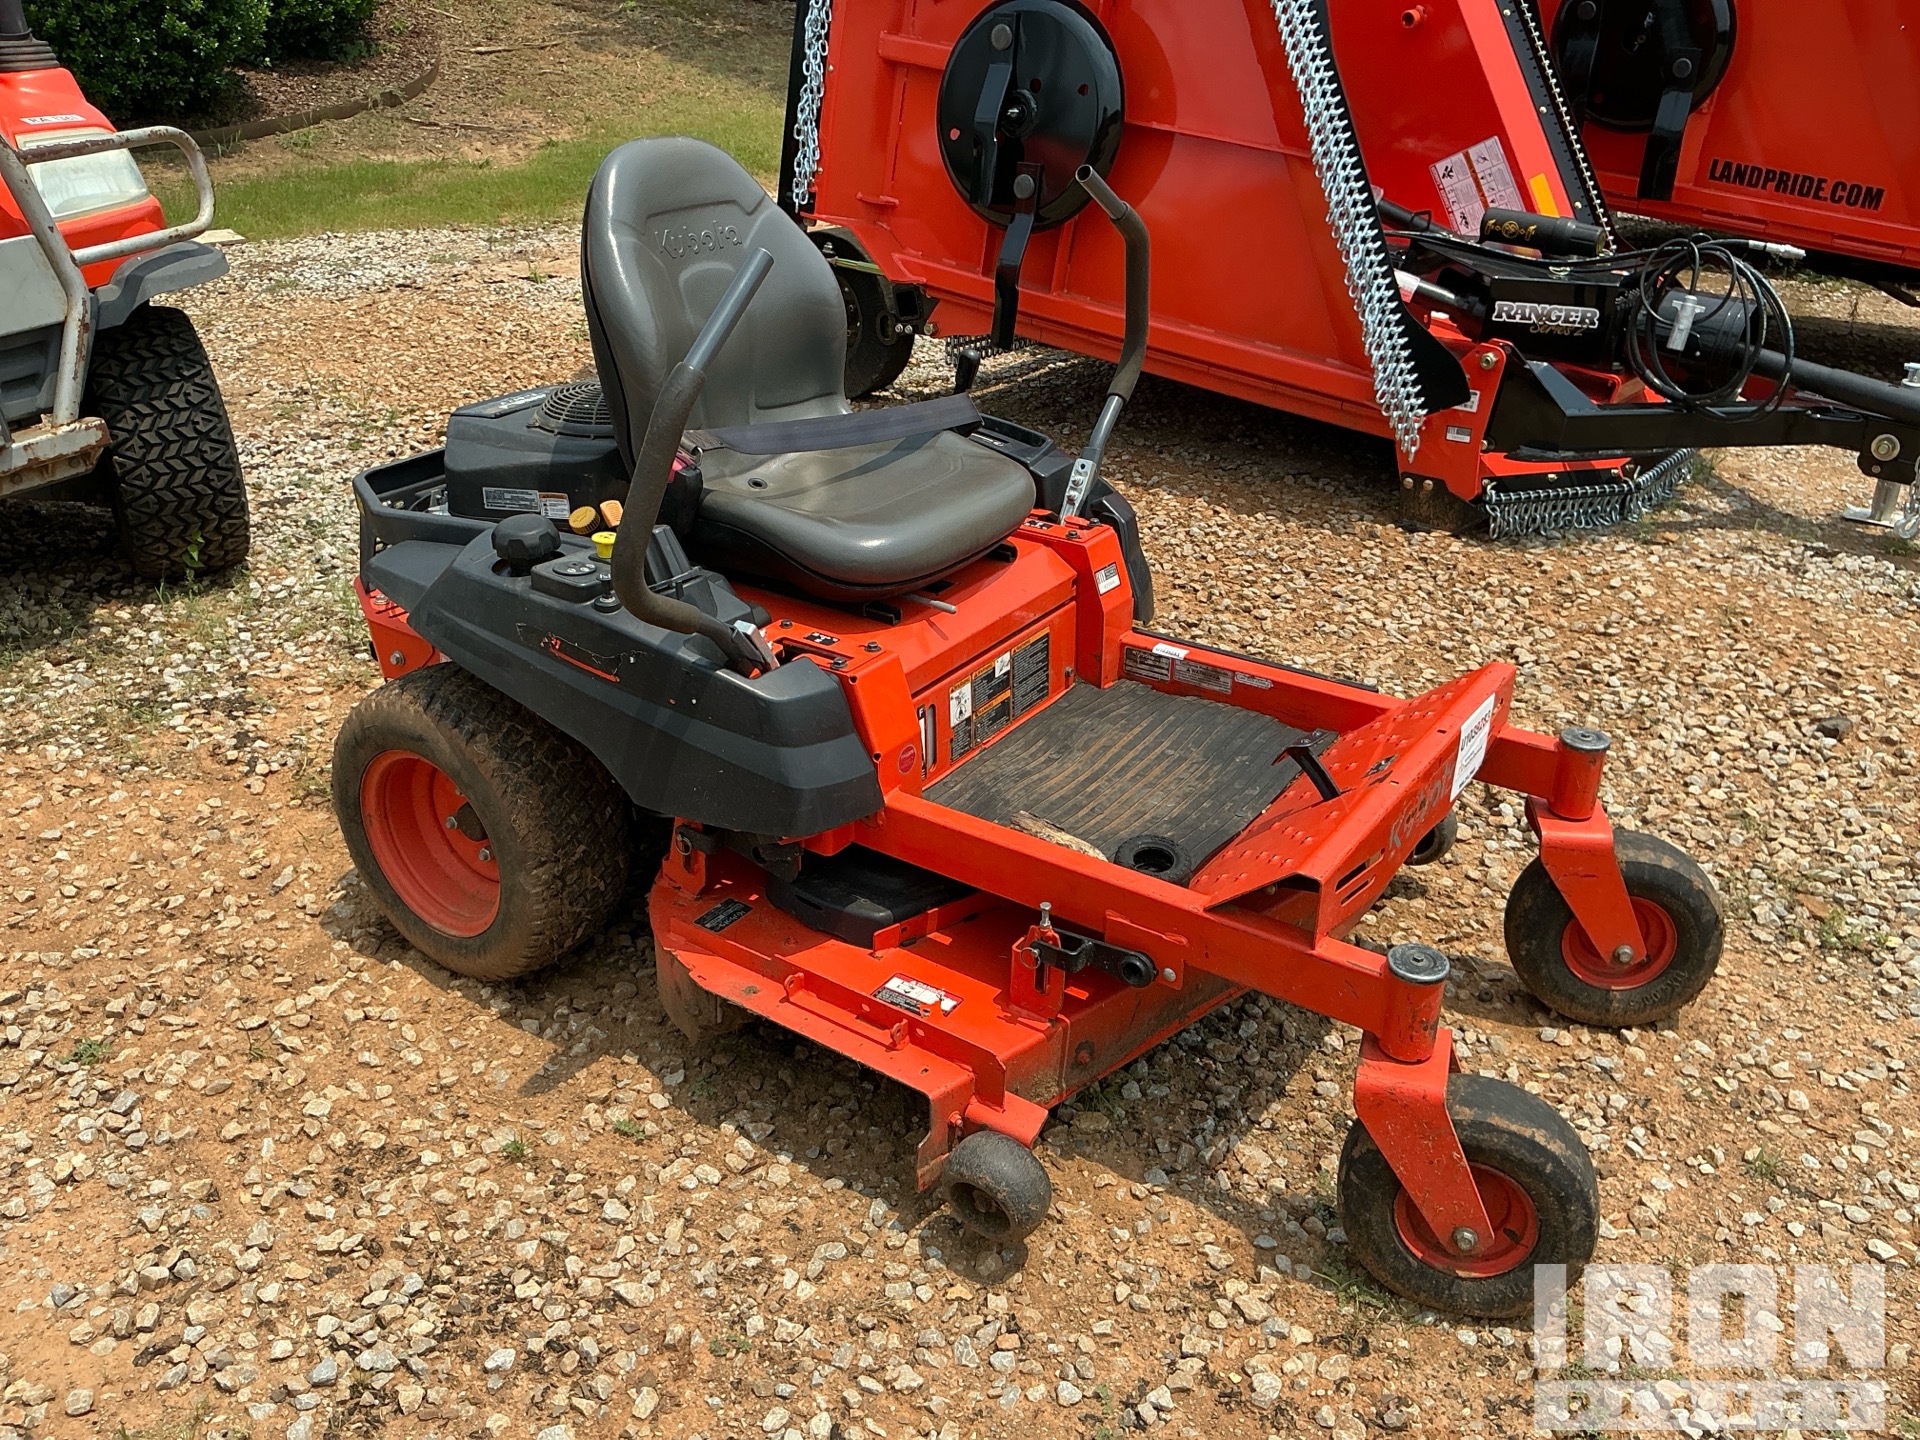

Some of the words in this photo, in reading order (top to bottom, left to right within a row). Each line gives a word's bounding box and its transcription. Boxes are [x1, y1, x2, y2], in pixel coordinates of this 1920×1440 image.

[1708, 158, 1885, 212] LANDPRIDE.COM
[654, 219, 743, 259] Kubota
[1492, 301, 1599, 328] RANGER
